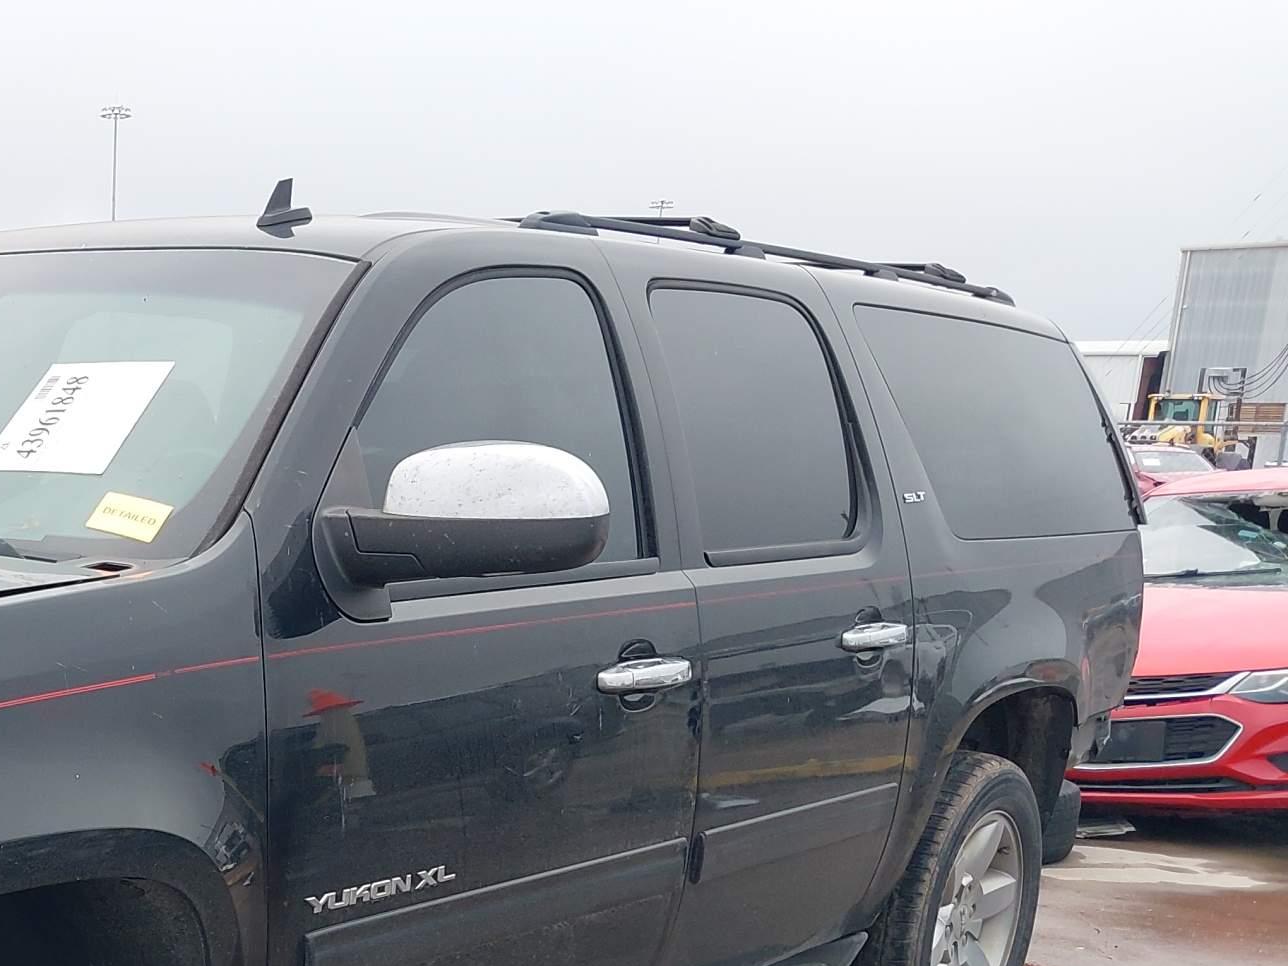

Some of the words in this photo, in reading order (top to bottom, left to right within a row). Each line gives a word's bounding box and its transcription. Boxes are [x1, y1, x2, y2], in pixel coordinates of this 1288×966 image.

[16, 375, 89, 459] 43961848
[903, 491, 926, 503] SLT
[102, 505, 157, 526] DETAILED
[304, 874, 412, 914] YUKON
[415, 865, 457, 890] XL
